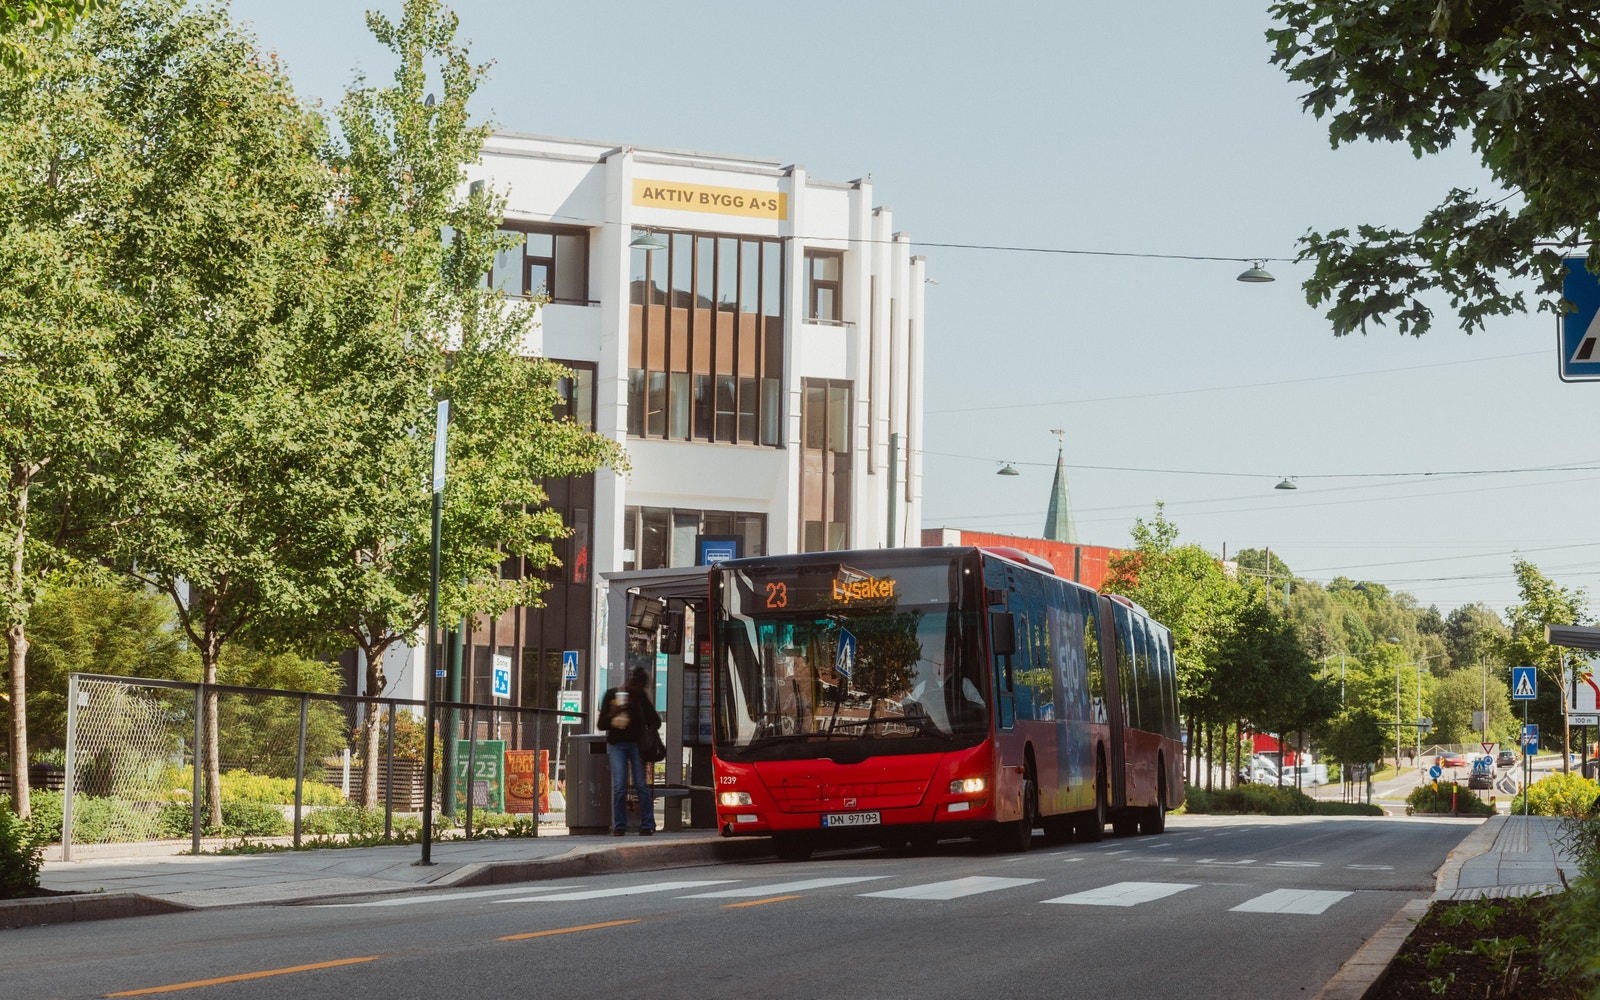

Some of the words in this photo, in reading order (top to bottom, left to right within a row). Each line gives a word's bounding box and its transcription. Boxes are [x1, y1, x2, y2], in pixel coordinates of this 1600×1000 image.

[642, 186, 694, 203] AKTIV
[699, 192, 744, 208] BYGG
[766, 581, 787, 608] 23
[833, 577, 896, 604] Lysaker
[496, 658, 508, 667] Sone
[507, 754, 542, 764] HAPP
[511, 763, 535, 773] HOU
[719, 776, 736, 785] 1239
[830, 815, 844, 825] DN
[848, 813, 878, 824] 97193
